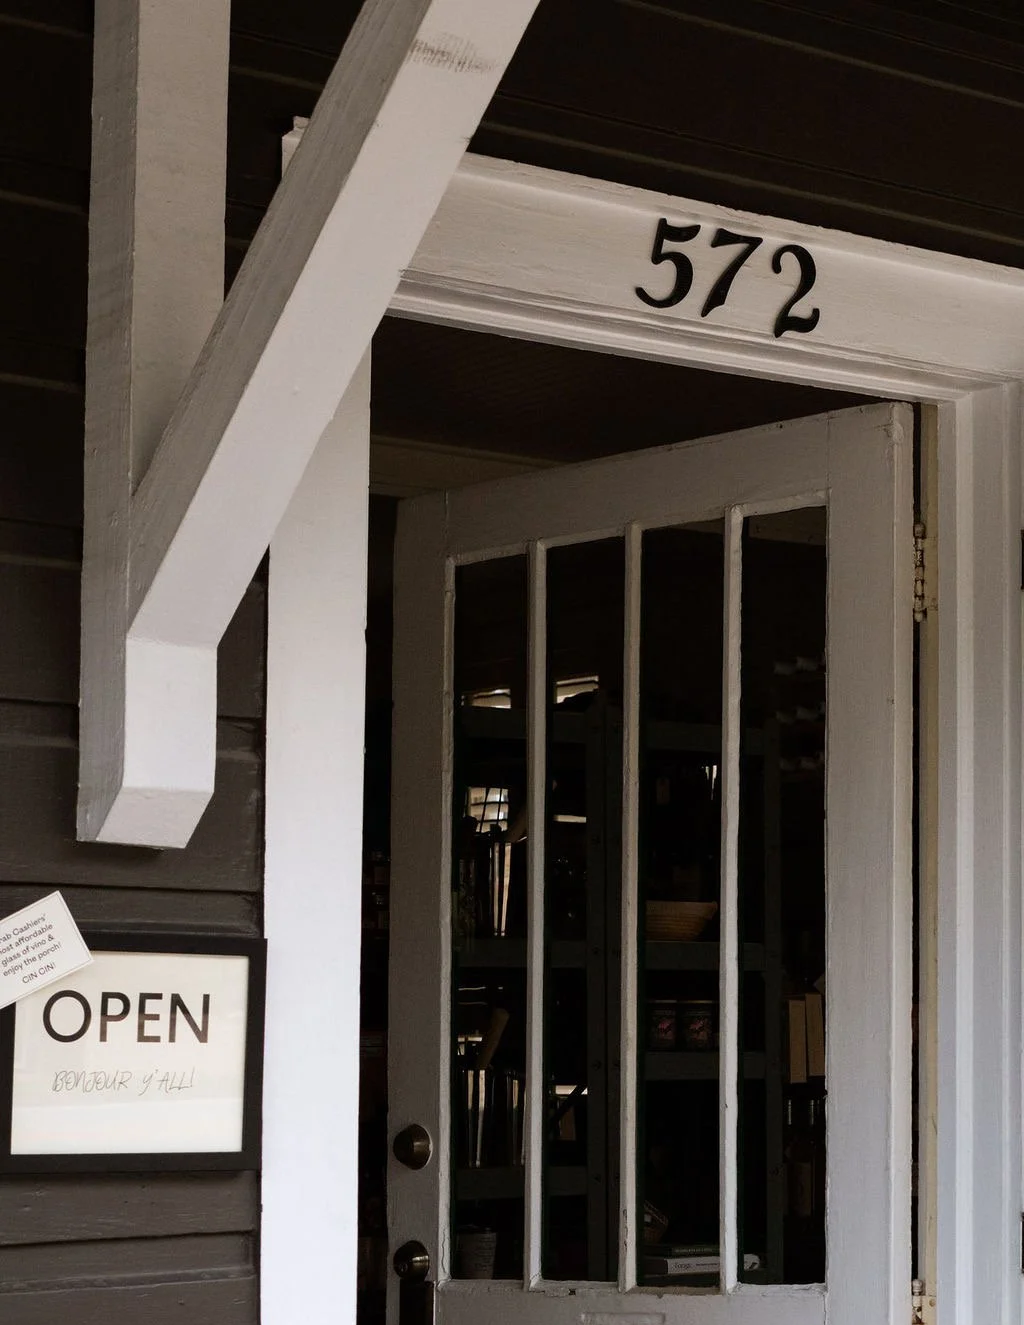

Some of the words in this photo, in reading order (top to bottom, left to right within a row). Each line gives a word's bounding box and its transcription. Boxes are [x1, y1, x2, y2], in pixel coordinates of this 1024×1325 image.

[634, 218, 821, 338] 572
[1, 952, 21, 967] glass
[22, 945, 30, 955] of
[30, 938, 47, 951] vino
[47, 933, 54, 942] &
[15, 924, 53, 947] affordable
[3, 963, 23, 977] enjoy
[23, 956, 37, 966] the
[38, 941, 61, 961] porch!
[22, 971, 38, 984] CIN
[38, 962, 56, 976] CIN!
[43, 989, 211, 1043] OPEN
[52, 1069, 133, 1094] BONJOUR
